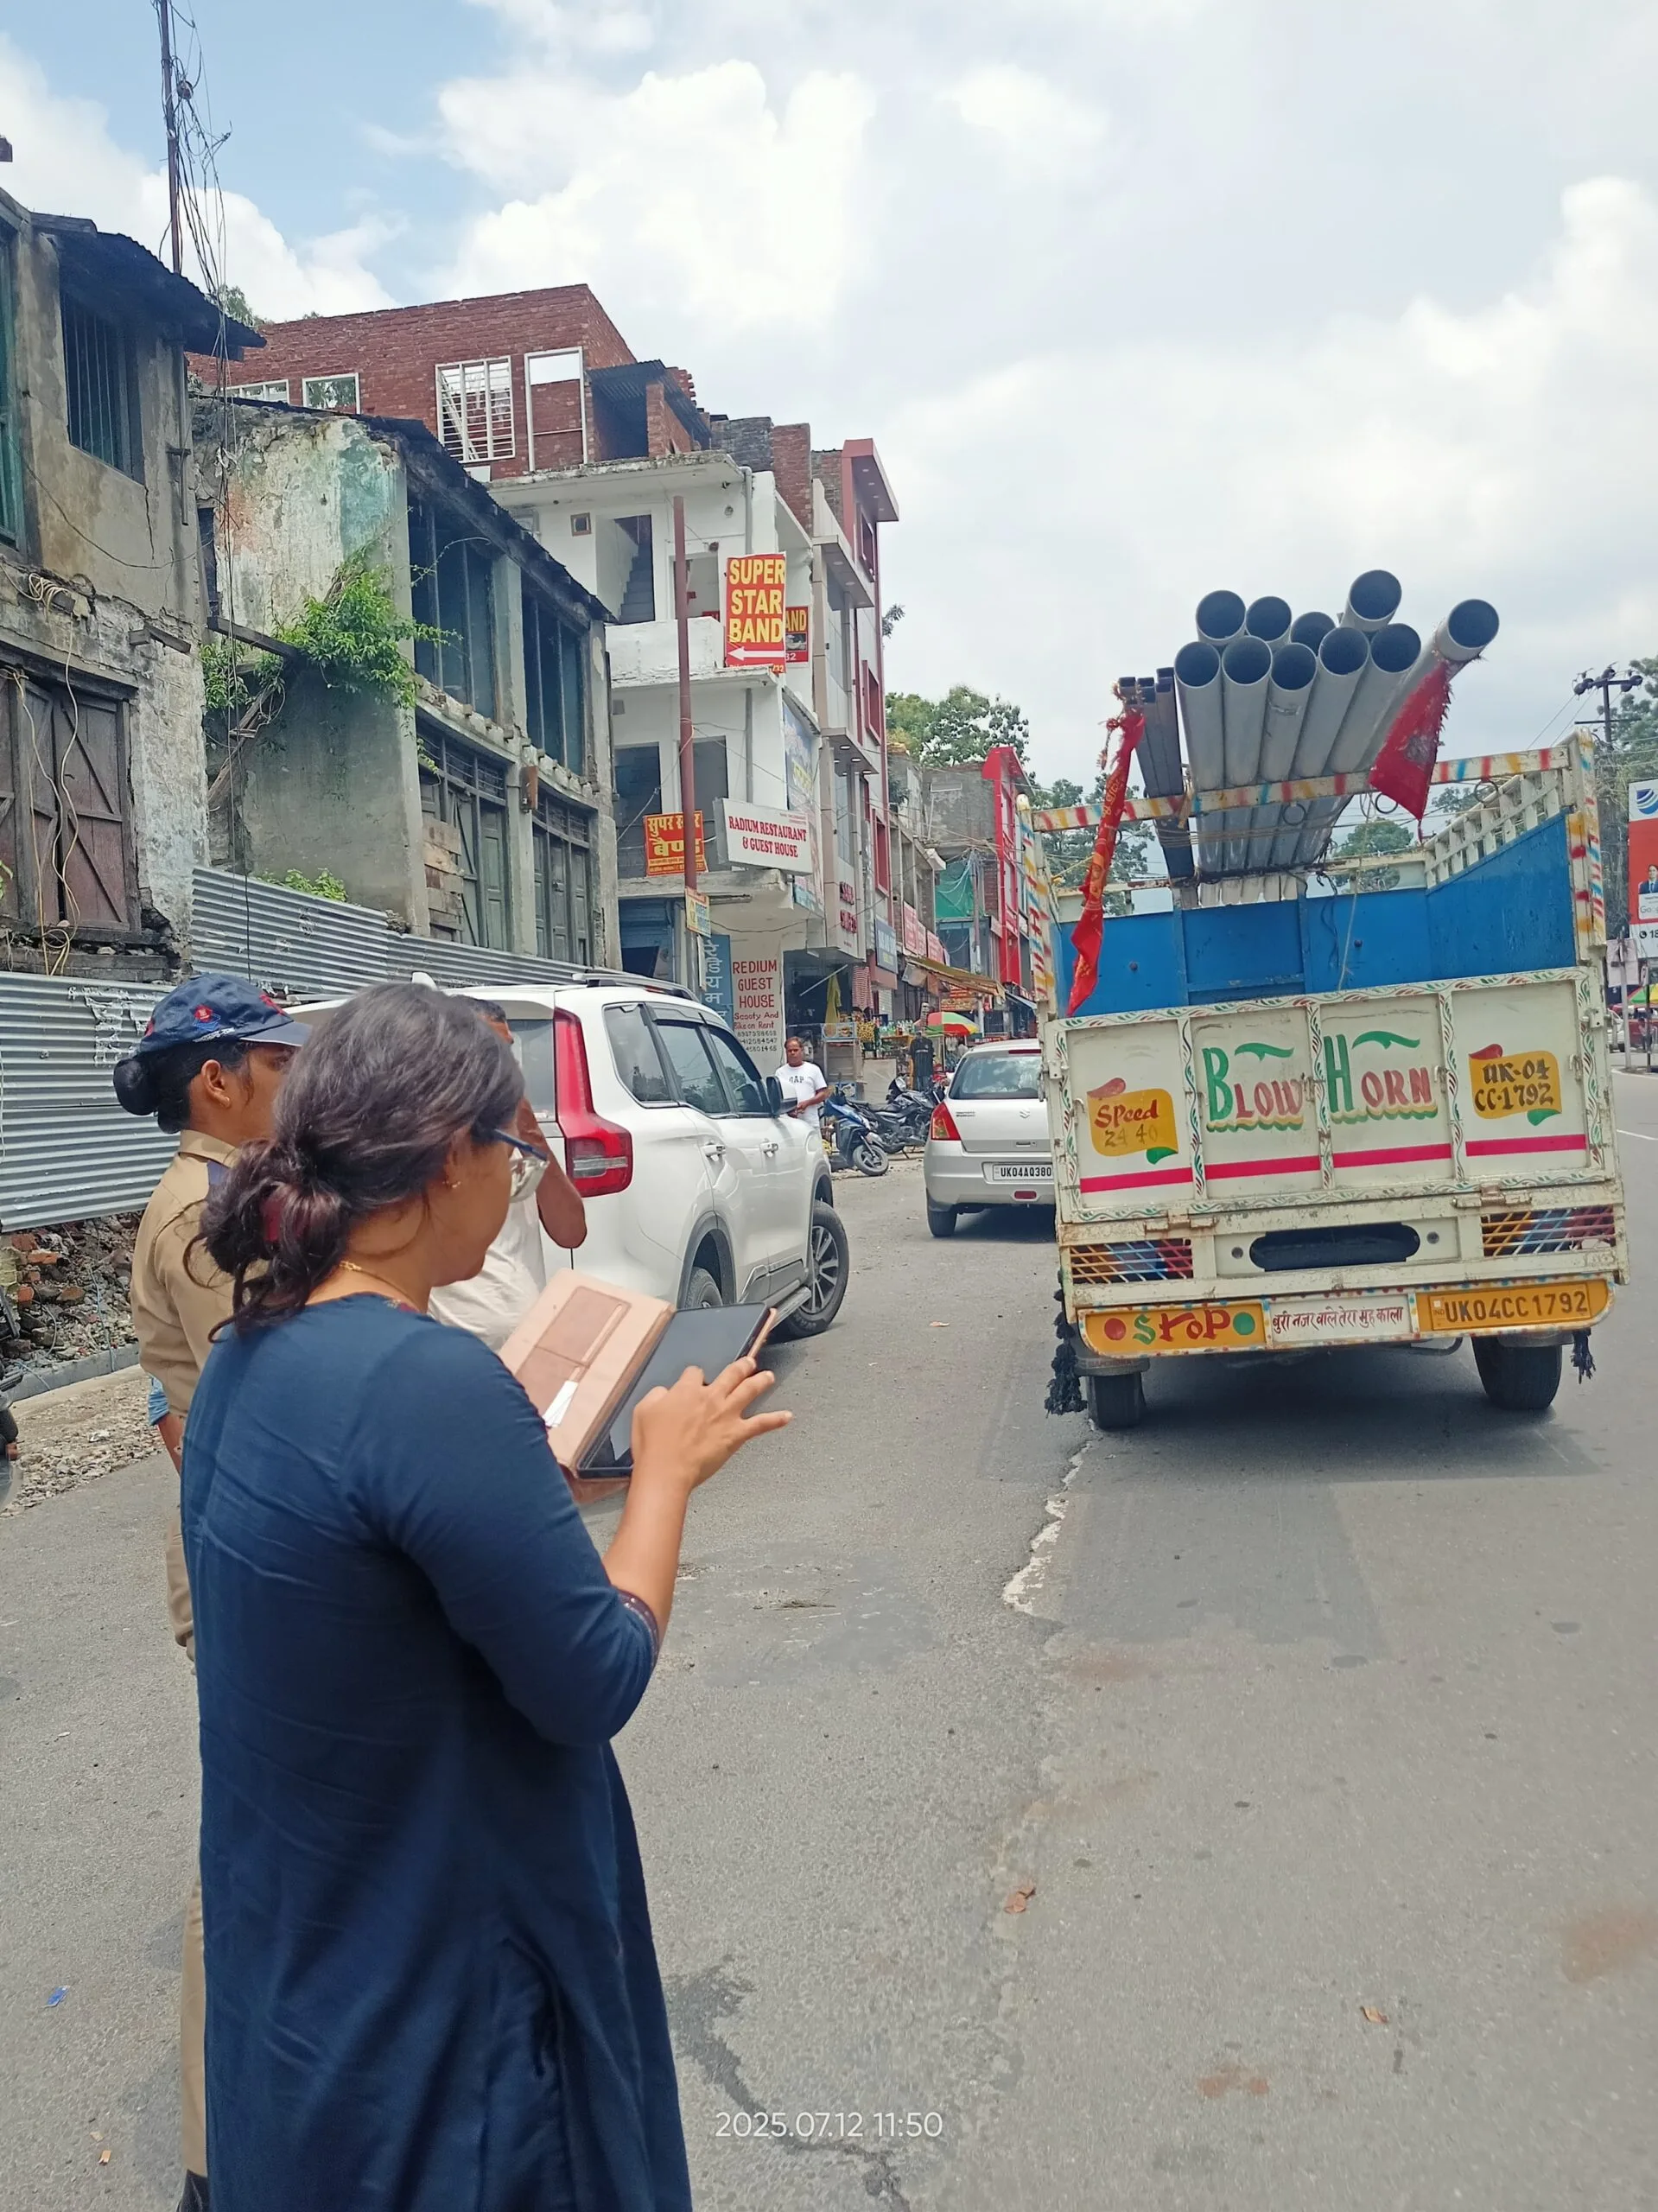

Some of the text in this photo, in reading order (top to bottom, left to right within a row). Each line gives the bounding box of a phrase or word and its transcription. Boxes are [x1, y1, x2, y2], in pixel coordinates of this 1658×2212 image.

[729, 558, 785, 584] SUPER
[731, 589, 783, 614] STAR
[728, 618, 783, 643] BAND
[785, 609, 807, 632] AND
[648, 816, 674, 837] सुपर
[728, 816, 759, 834] RADIUM
[759, 821, 807, 842] RESTAURANT
[742, 836, 798, 858] & GUEST HOUSE
[733, 959, 778, 974] REDIUM
[738, 977, 773, 991] GUEST
[739, 994, 775, 1008] HOUSE
[734, 1012, 761, 1020] Scooty
[758, 1020, 774, 1029] Rent
[1202, 1033, 1432, 1122] BLOW HORN
[1483, 1058, 1551, 1084] UK-04
[1001, 1166, 1052, 1177] UK04AQ380
[1444, 1290, 1588, 1323] UK04CC1792
[1273, 1311, 1292, 1334] बुरी
[1293, 1313, 1319, 1331] नजर
[1338, 1306, 1357, 1327] तेरा
[1376, 1306, 1404, 1325] काला
